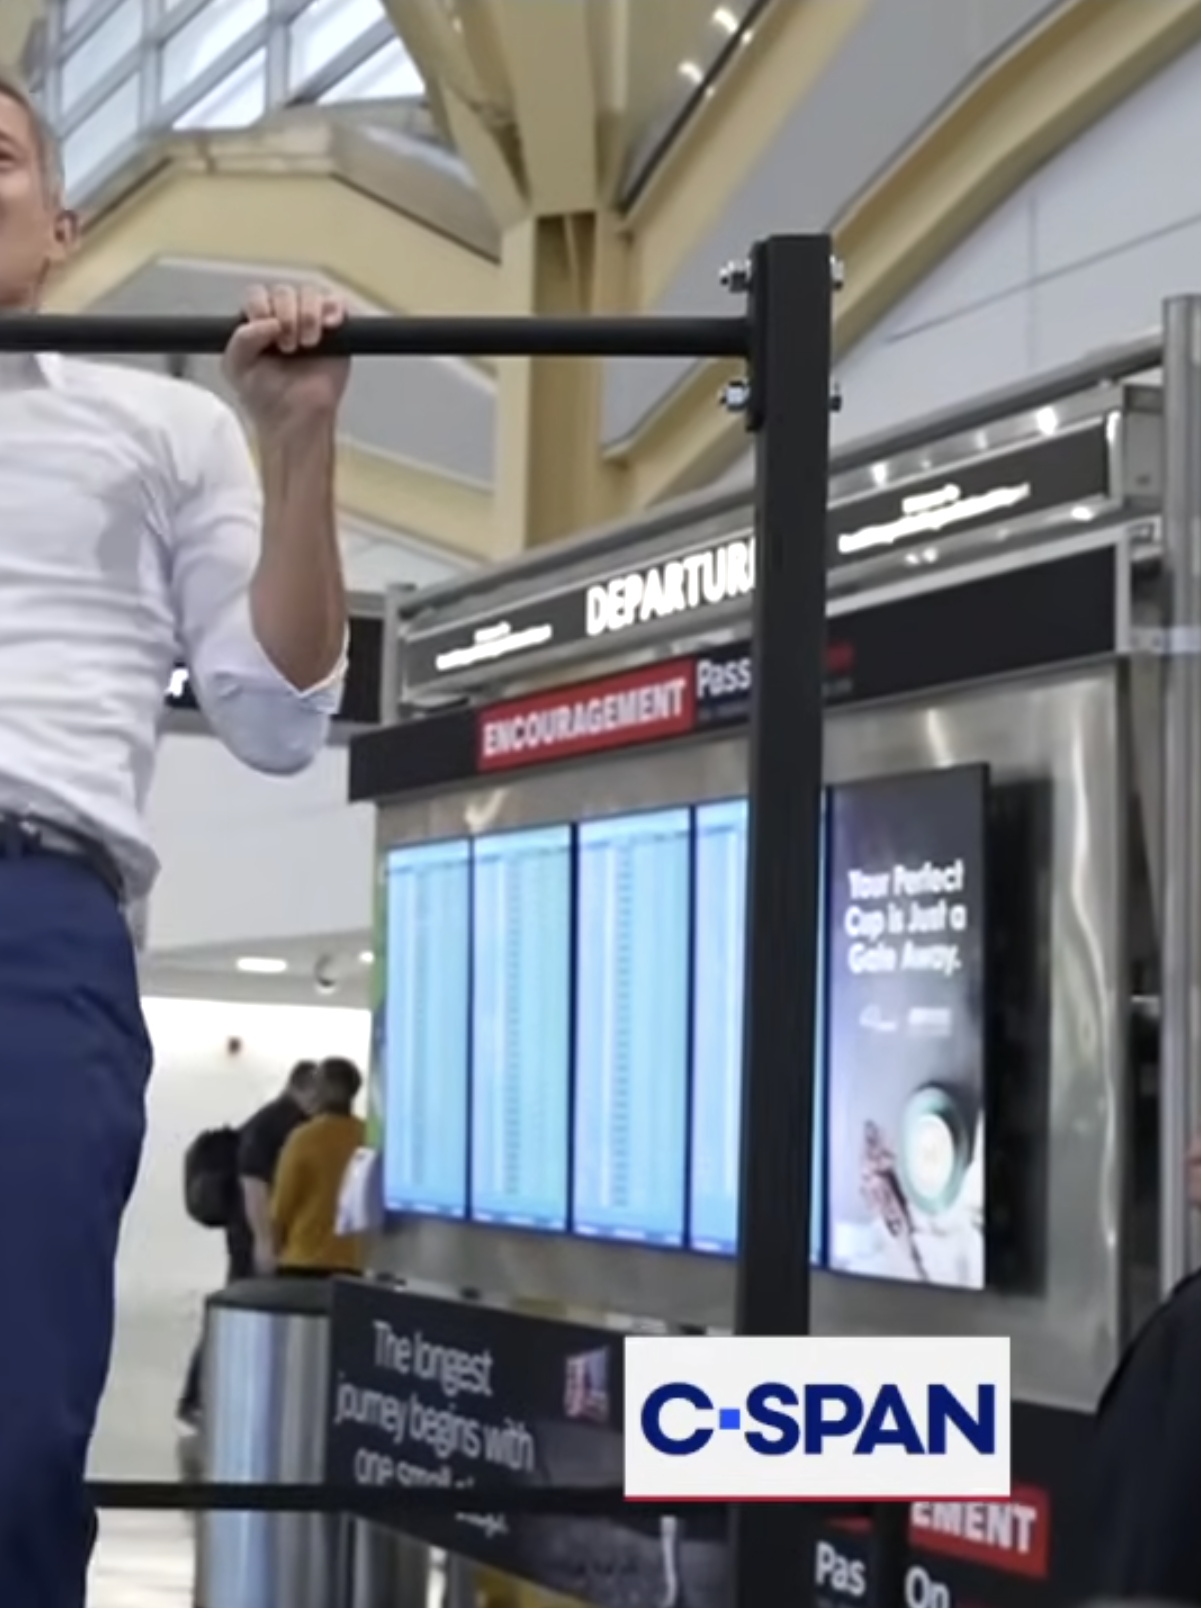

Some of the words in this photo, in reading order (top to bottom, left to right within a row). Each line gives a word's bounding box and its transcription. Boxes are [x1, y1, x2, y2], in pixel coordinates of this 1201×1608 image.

[586, 537, 756, 636] DEPARTUR
[483, 677, 687, 758] ENCOURAGEMENT
[697, 657, 751, 699] Pass
[373, 1319, 411, 1375] The
[413, 1331, 493, 1397] longest
[334, 1371, 407, 1445] journey
[408, 1393, 481, 1459] begins
[483, 1416, 535, 1472] with
